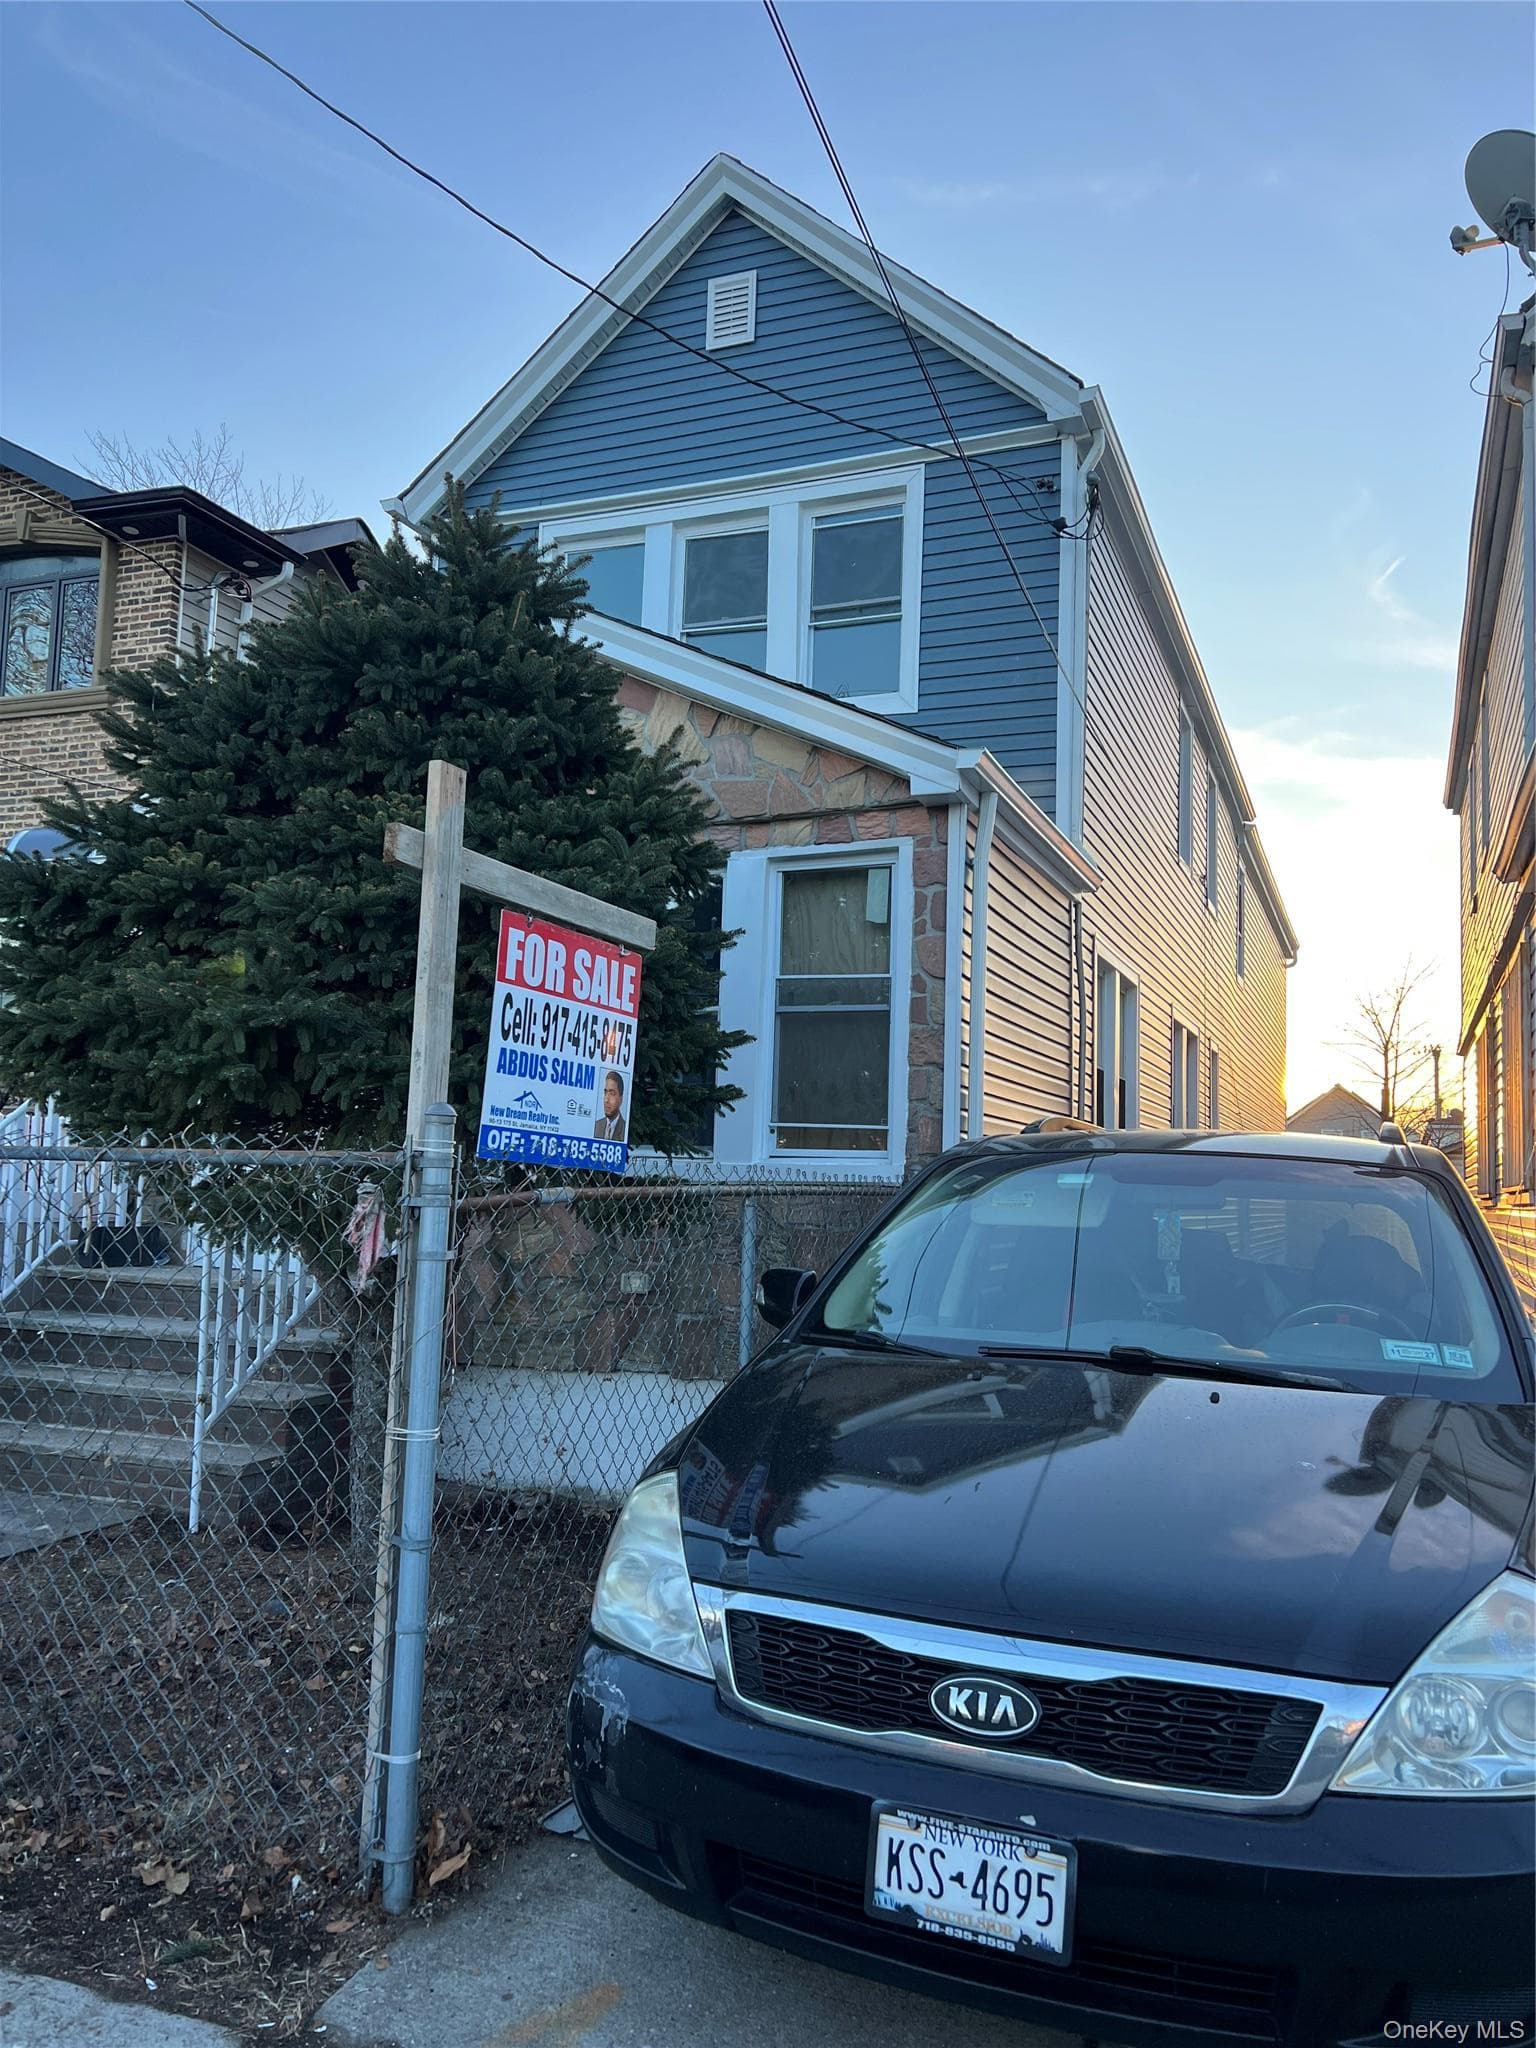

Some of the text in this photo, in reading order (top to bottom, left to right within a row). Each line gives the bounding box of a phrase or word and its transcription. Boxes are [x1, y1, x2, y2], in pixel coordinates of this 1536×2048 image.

[504, 927, 636, 1014] FOR SALE
[501, 992, 632, 1067] Cell: 917-415-8475
[496, 1047, 596, 1090] ABDUS SALAM
[490, 1105, 505, 1117] New
[506, 1107, 528, 1120] Dream
[528, 1111, 549, 1124] Realty
[487, 1129, 525, 1153] OFF:
[948, 1686, 1018, 1728] KIA
[923, 1822, 1023, 1862] NEW YORK
[887, 1837, 1055, 1927] KSS 4695
